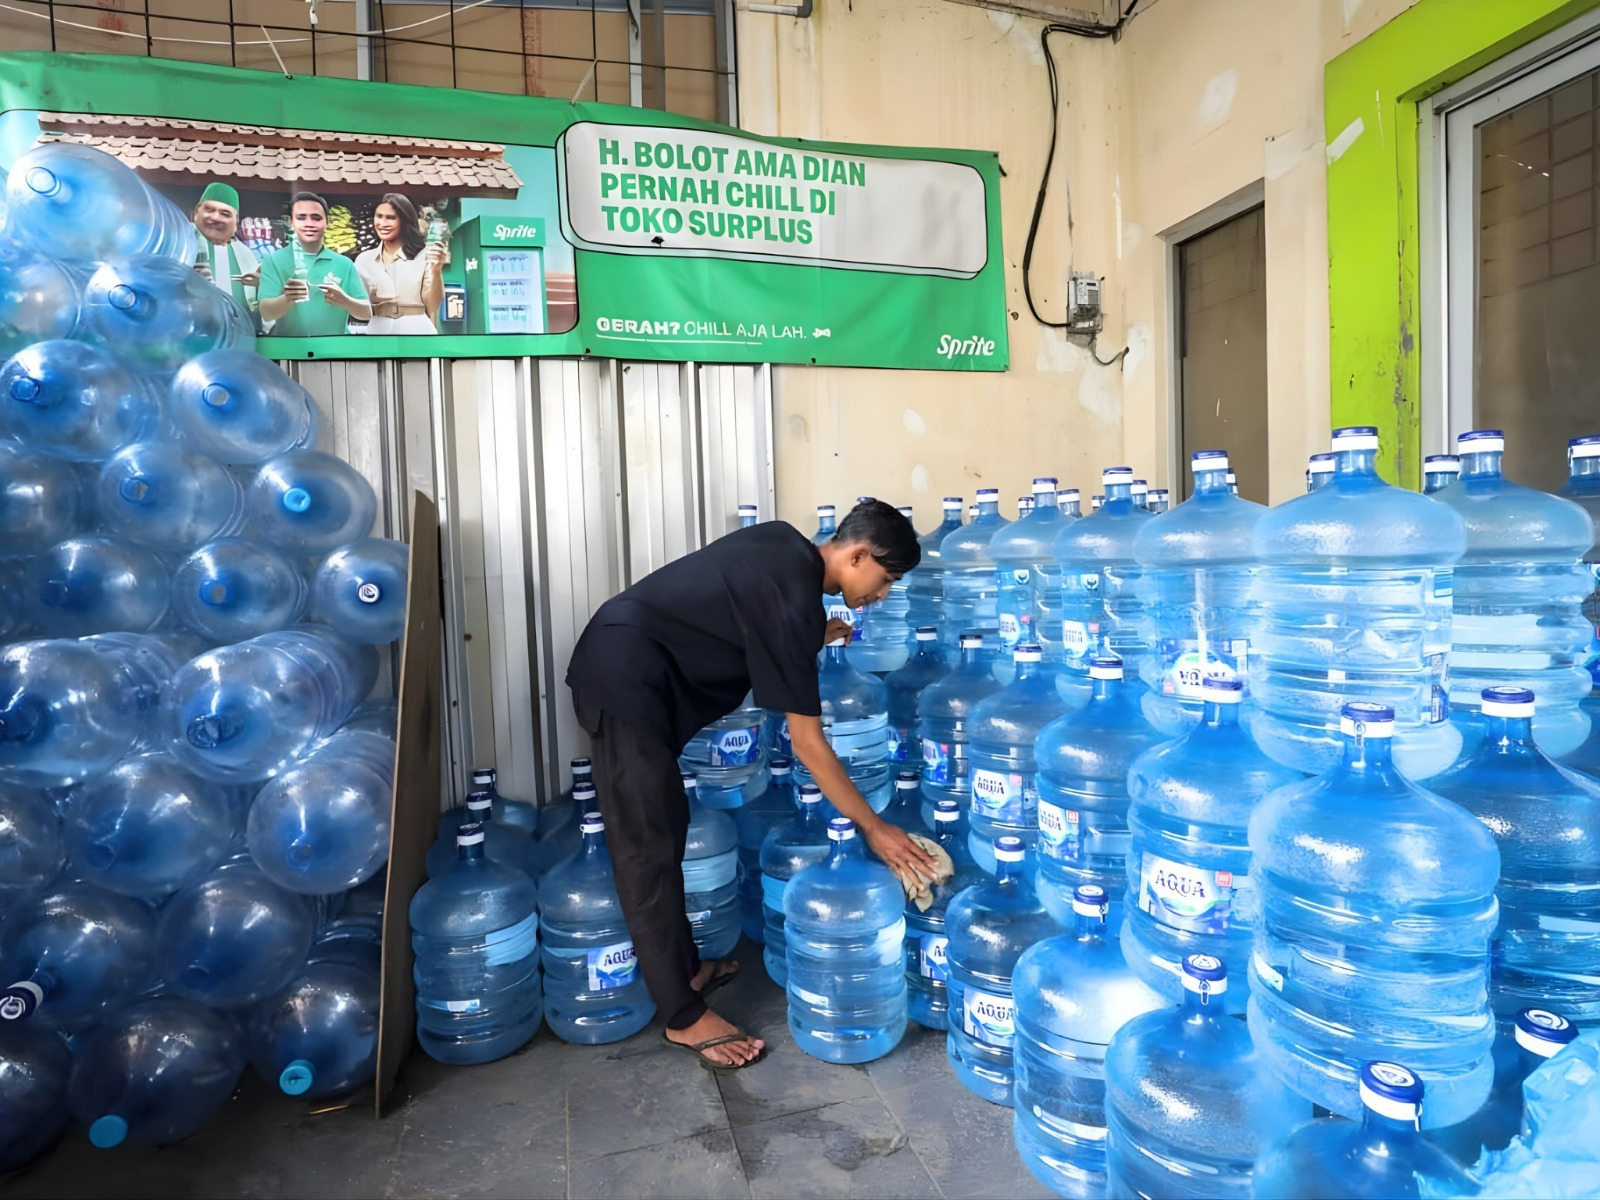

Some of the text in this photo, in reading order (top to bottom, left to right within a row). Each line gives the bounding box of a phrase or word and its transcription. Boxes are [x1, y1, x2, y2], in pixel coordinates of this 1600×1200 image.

[599, 138, 866, 187] H. BOLOT AMA DIAN
[601, 172, 836, 216] PERNAH CHILL DI
[493, 224, 536, 241] Sprite
[601, 205, 813, 245] TOKO SURPLUS
[736, 323, 768, 338] AJA
[772, 324, 807, 339] LAH.
[937, 334, 995, 360] Sprite
[1155, 869, 1206, 898] AQUA
